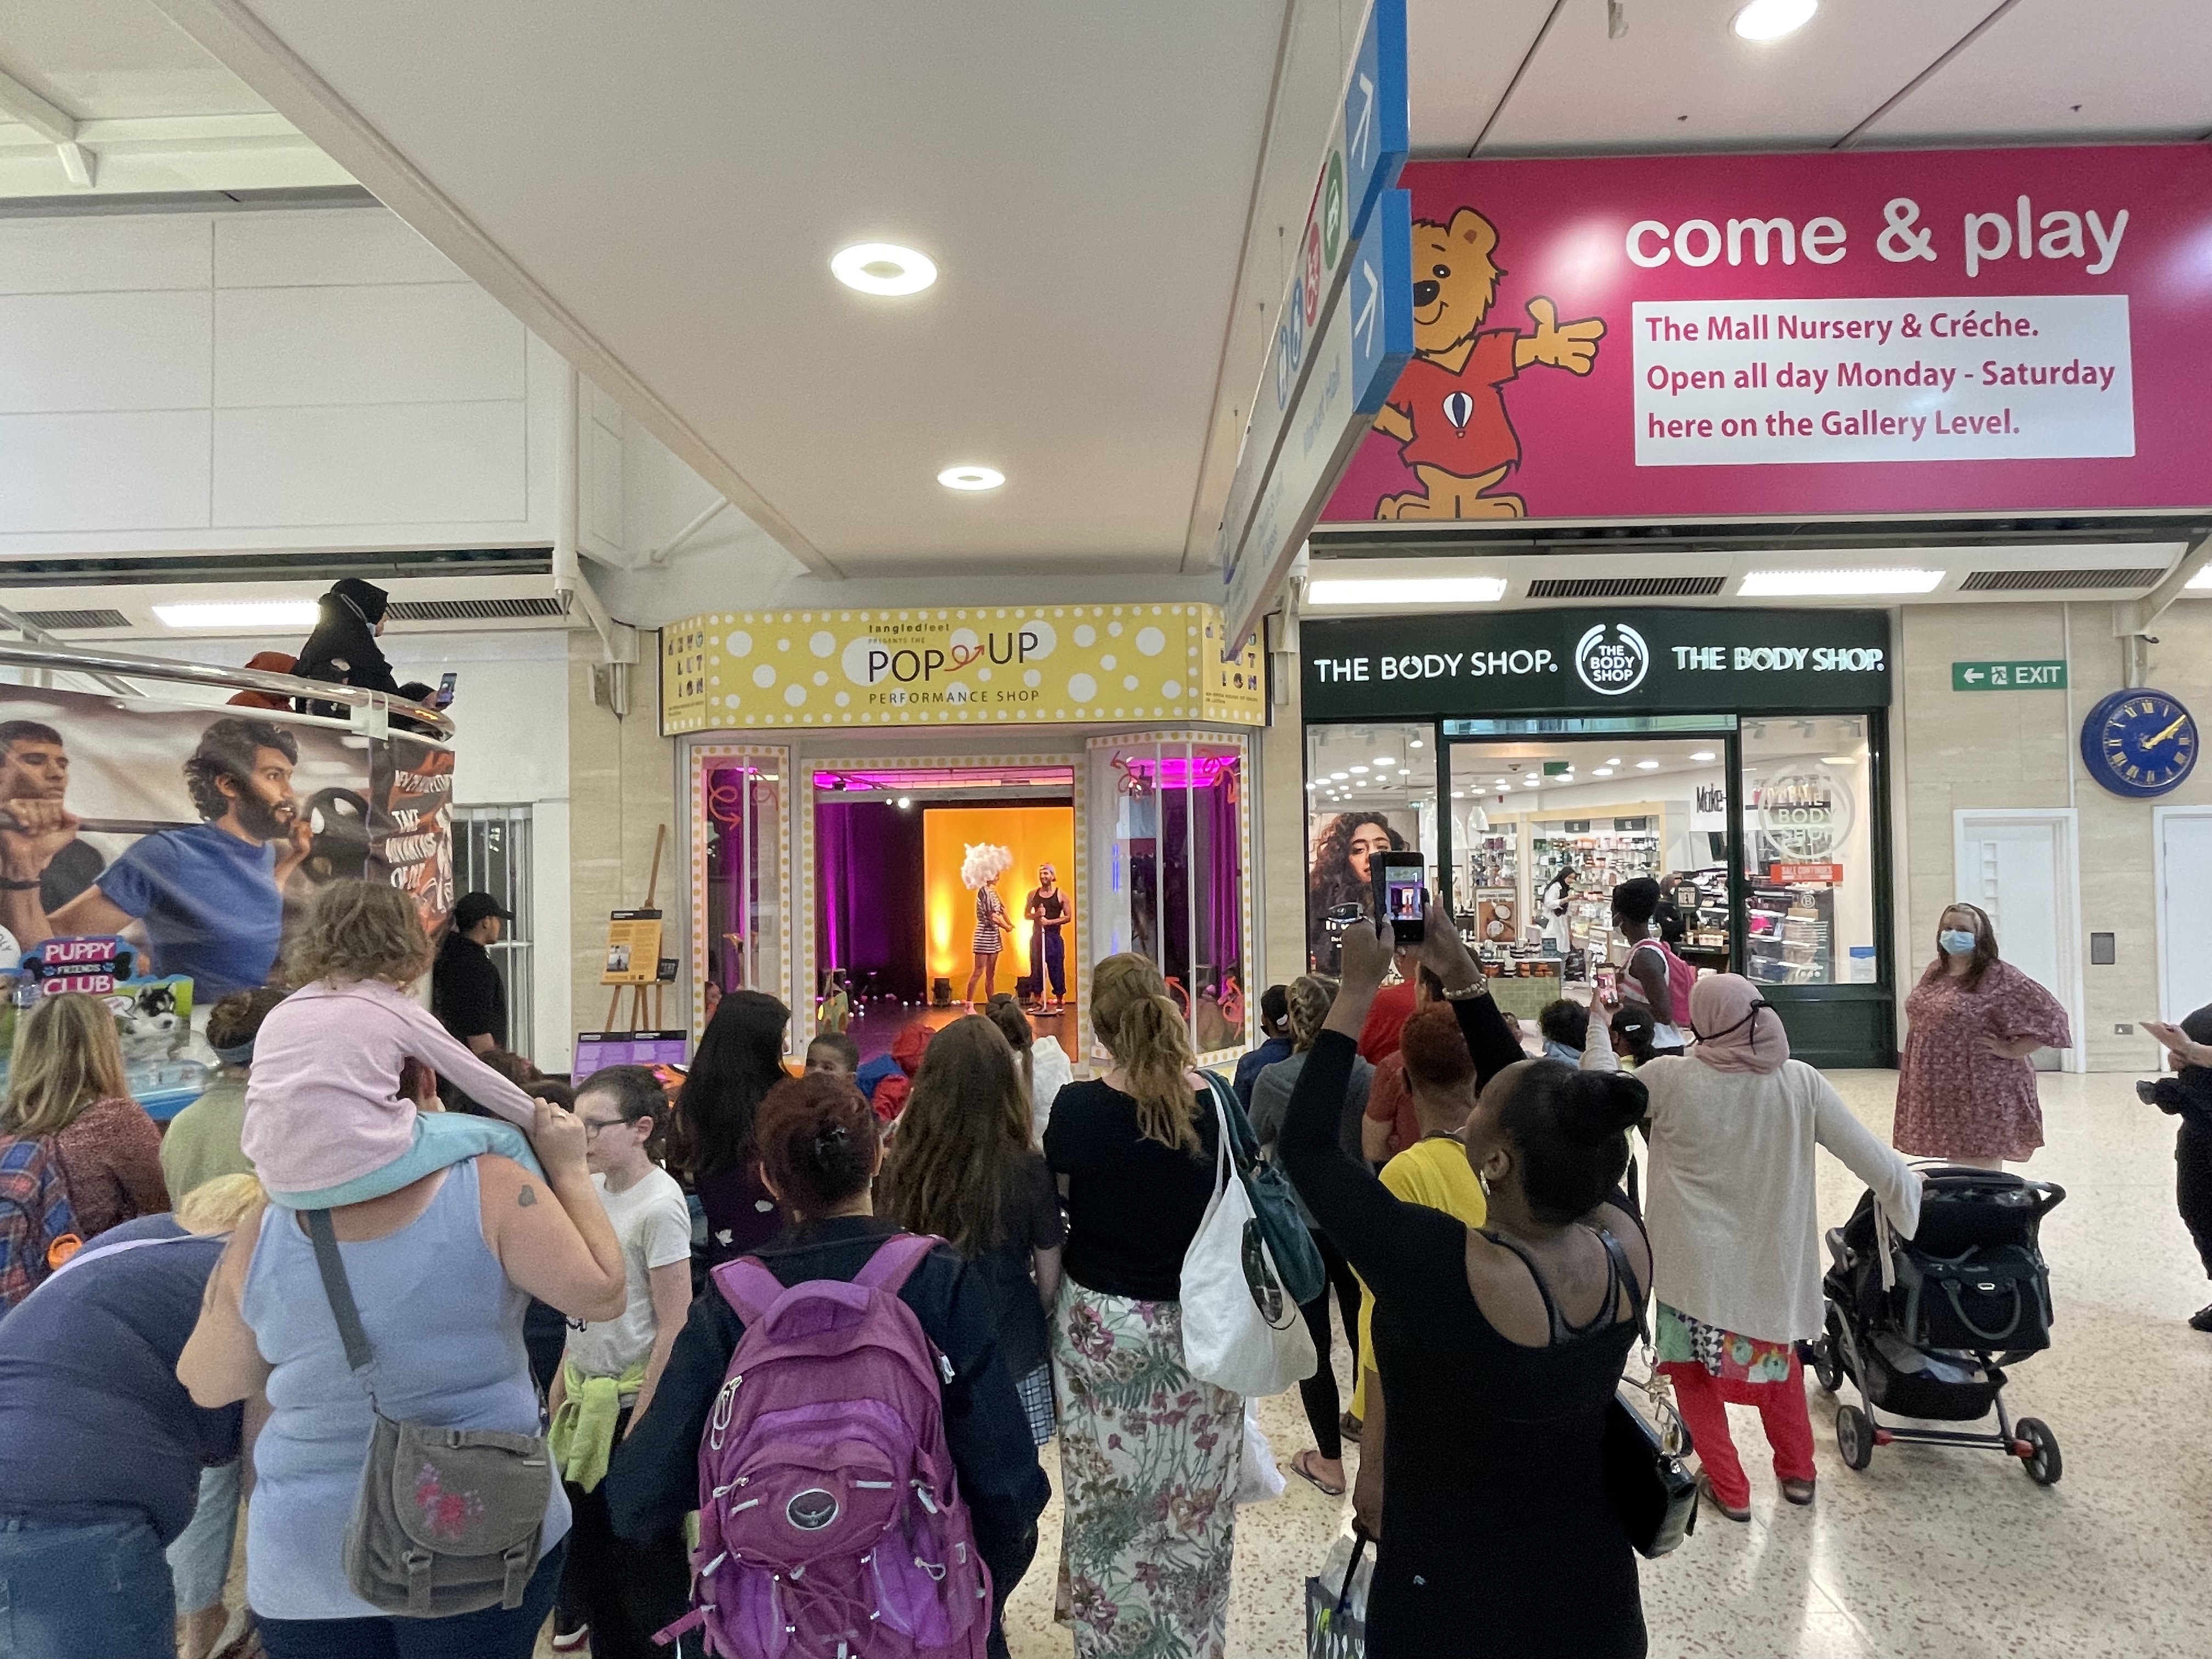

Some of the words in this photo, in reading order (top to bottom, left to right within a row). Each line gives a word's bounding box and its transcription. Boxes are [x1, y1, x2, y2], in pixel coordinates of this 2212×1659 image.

[1626, 216, 1847, 268] come
[1876, 198, 1937, 262] &
[1965, 195, 2129, 277] play
[1646, 316, 1699, 341] The
[1708, 314, 1768, 340] Mall
[1778, 314, 1893, 345] Nursery
[1901, 313, 1922, 338] &
[1930, 310, 2039, 338] Créche.
[1647, 365, 1725, 396] Open
[1734, 362, 1767, 388] all
[1776, 362, 1829, 394] day
[1838, 360, 1956, 393] Monday
[1982, 358, 2115, 392] Saturday
[1649, 413, 1712, 438] here
[1722, 419, 1756, 437] on
[1765, 410, 1813, 436] the
[1821, 409, 1927, 442] Gallery
[1936, 408, 2019, 435] Level.
[869, 650, 945, 682] POP
[989, 632, 1039, 665] UP
[1598, 645, 1624, 656] THE
[1671, 646, 1727, 670] THE
[1734, 647, 1810, 671] BODY
[1314, 657, 1369, 682] THE
[1381, 653, 1463, 681] BODY
[1590, 656, 1635, 669] BODY
[1593, 669, 1634, 681] SHOP
[2016, 665, 2061, 684] EXIT
[870, 691, 988, 704] PERFORMANCE
[996, 690, 1040, 702] SHOP
[1779, 808, 1837, 823] BODY
[45, 941, 116, 962] PUPPY
[43, 975, 112, 996] CLUB
